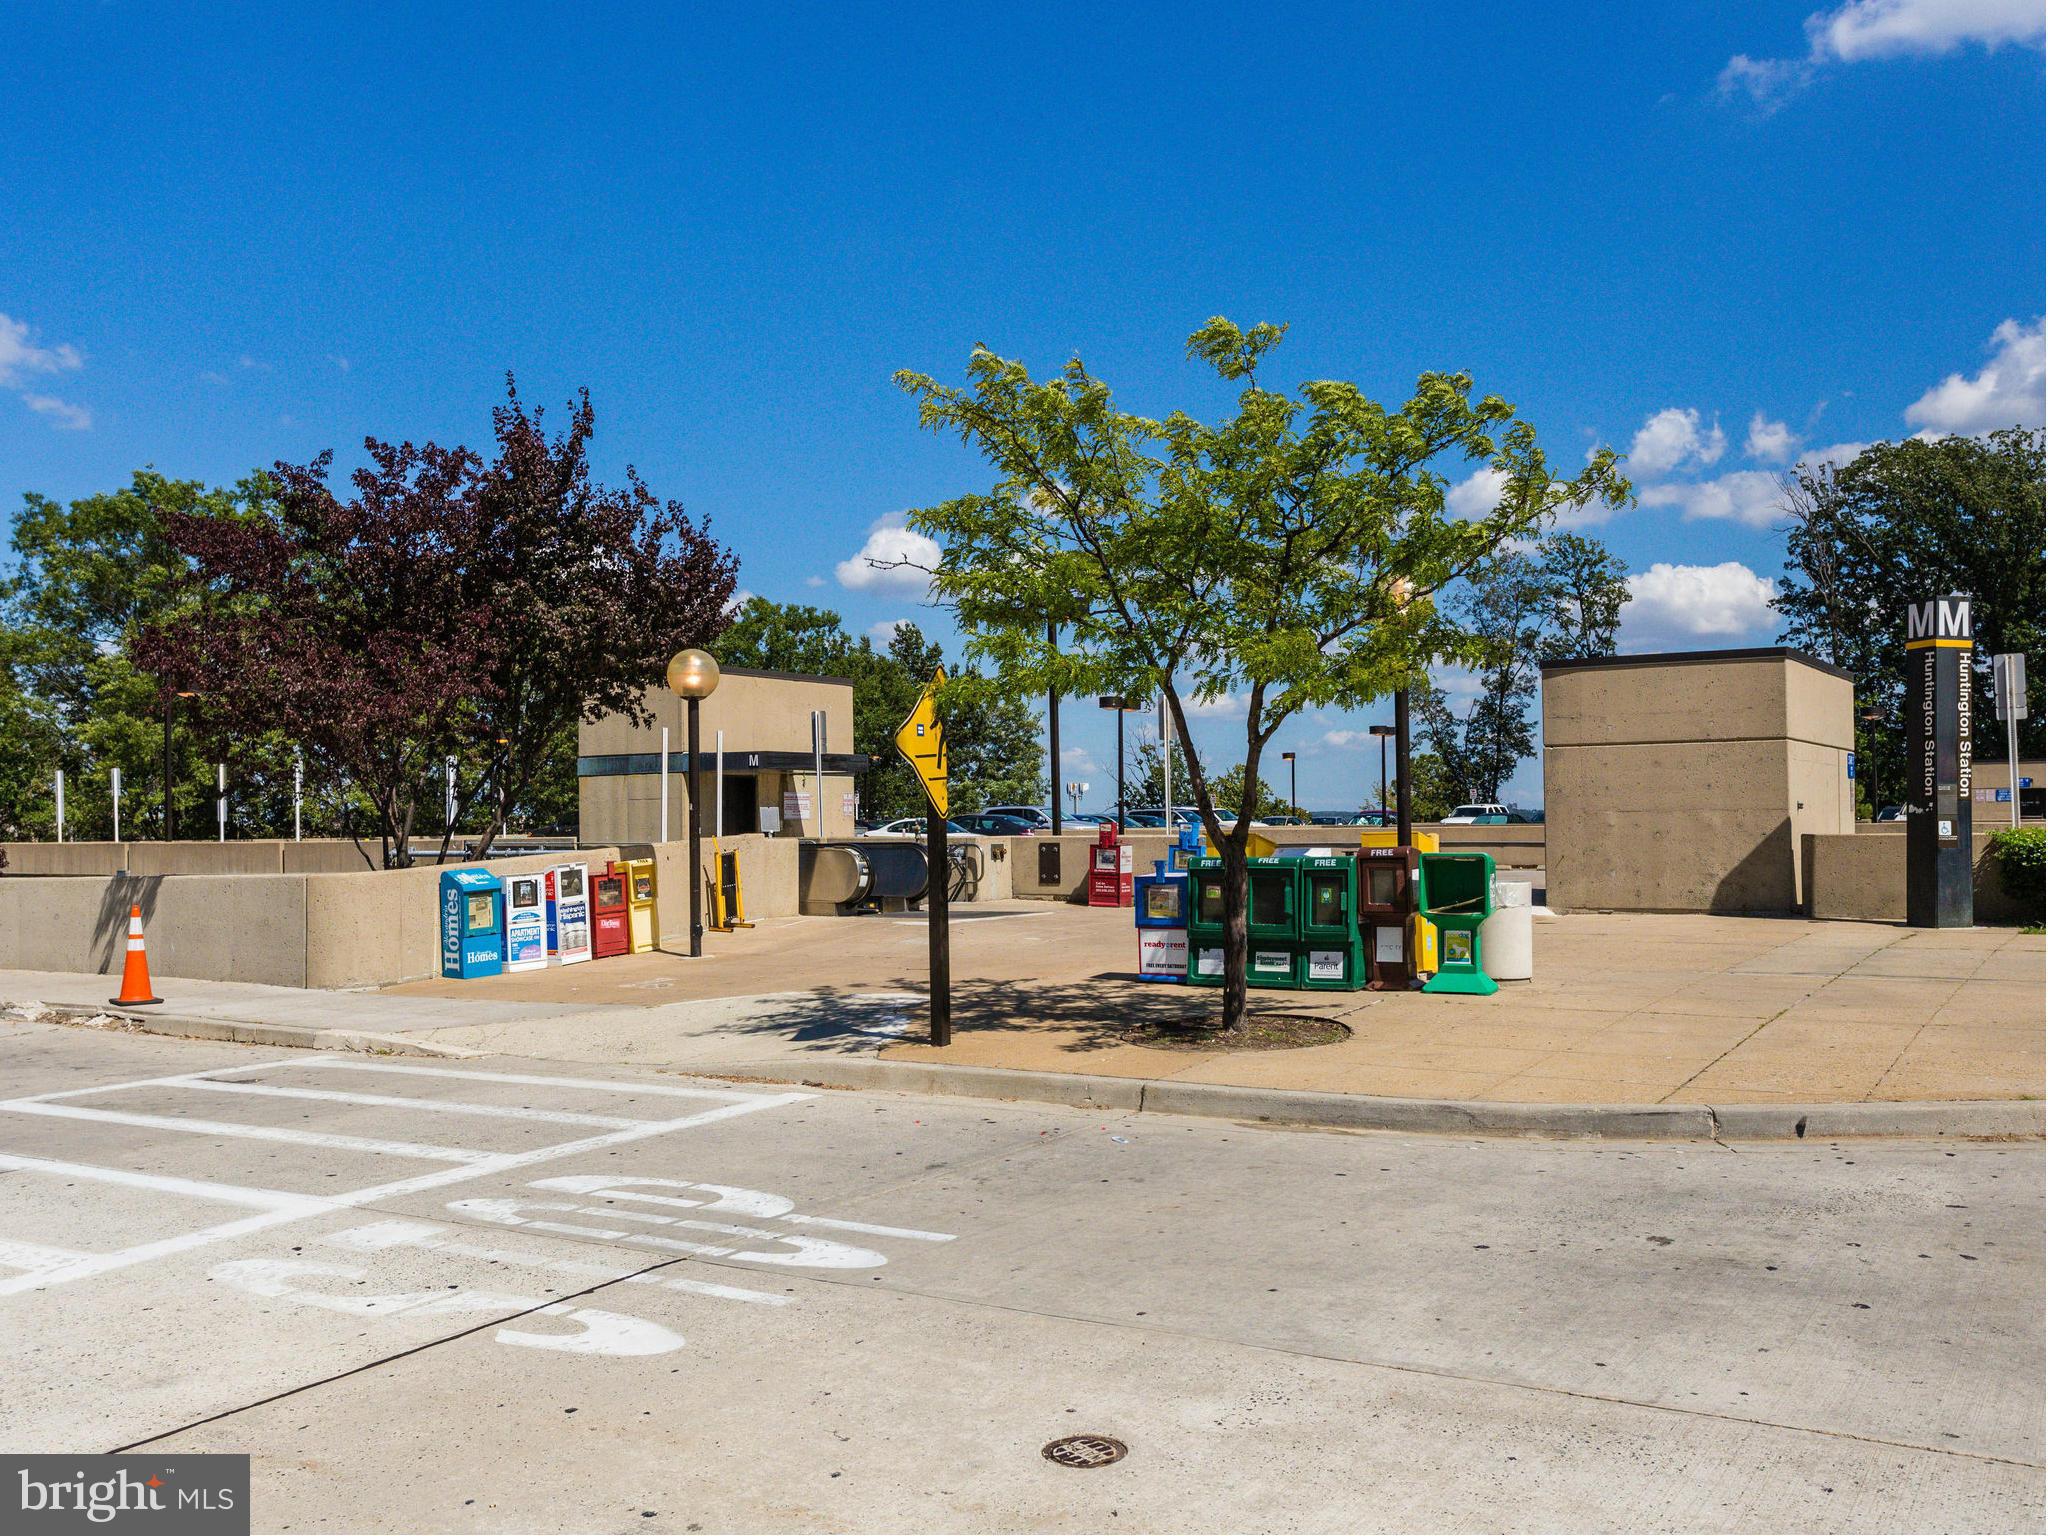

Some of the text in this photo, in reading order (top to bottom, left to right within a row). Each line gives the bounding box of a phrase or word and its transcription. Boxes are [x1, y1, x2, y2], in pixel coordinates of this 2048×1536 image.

[1908, 601, 1934, 639] M
[1938, 600, 1970, 637] M
[1923, 651, 1935, 796] Huntington Station
[1958, 652, 1972, 797] Huntington Station
[749, 754, 759, 766] M
[1201, 859, 1222, 867] FREE
[1314, 859, 1337, 867] FREE
[444, 888, 460, 972] Homes
[511, 927, 540, 937] APARTMENT
[467, 951, 498, 964] Homes
[1314, 961, 1338, 970] Parent
